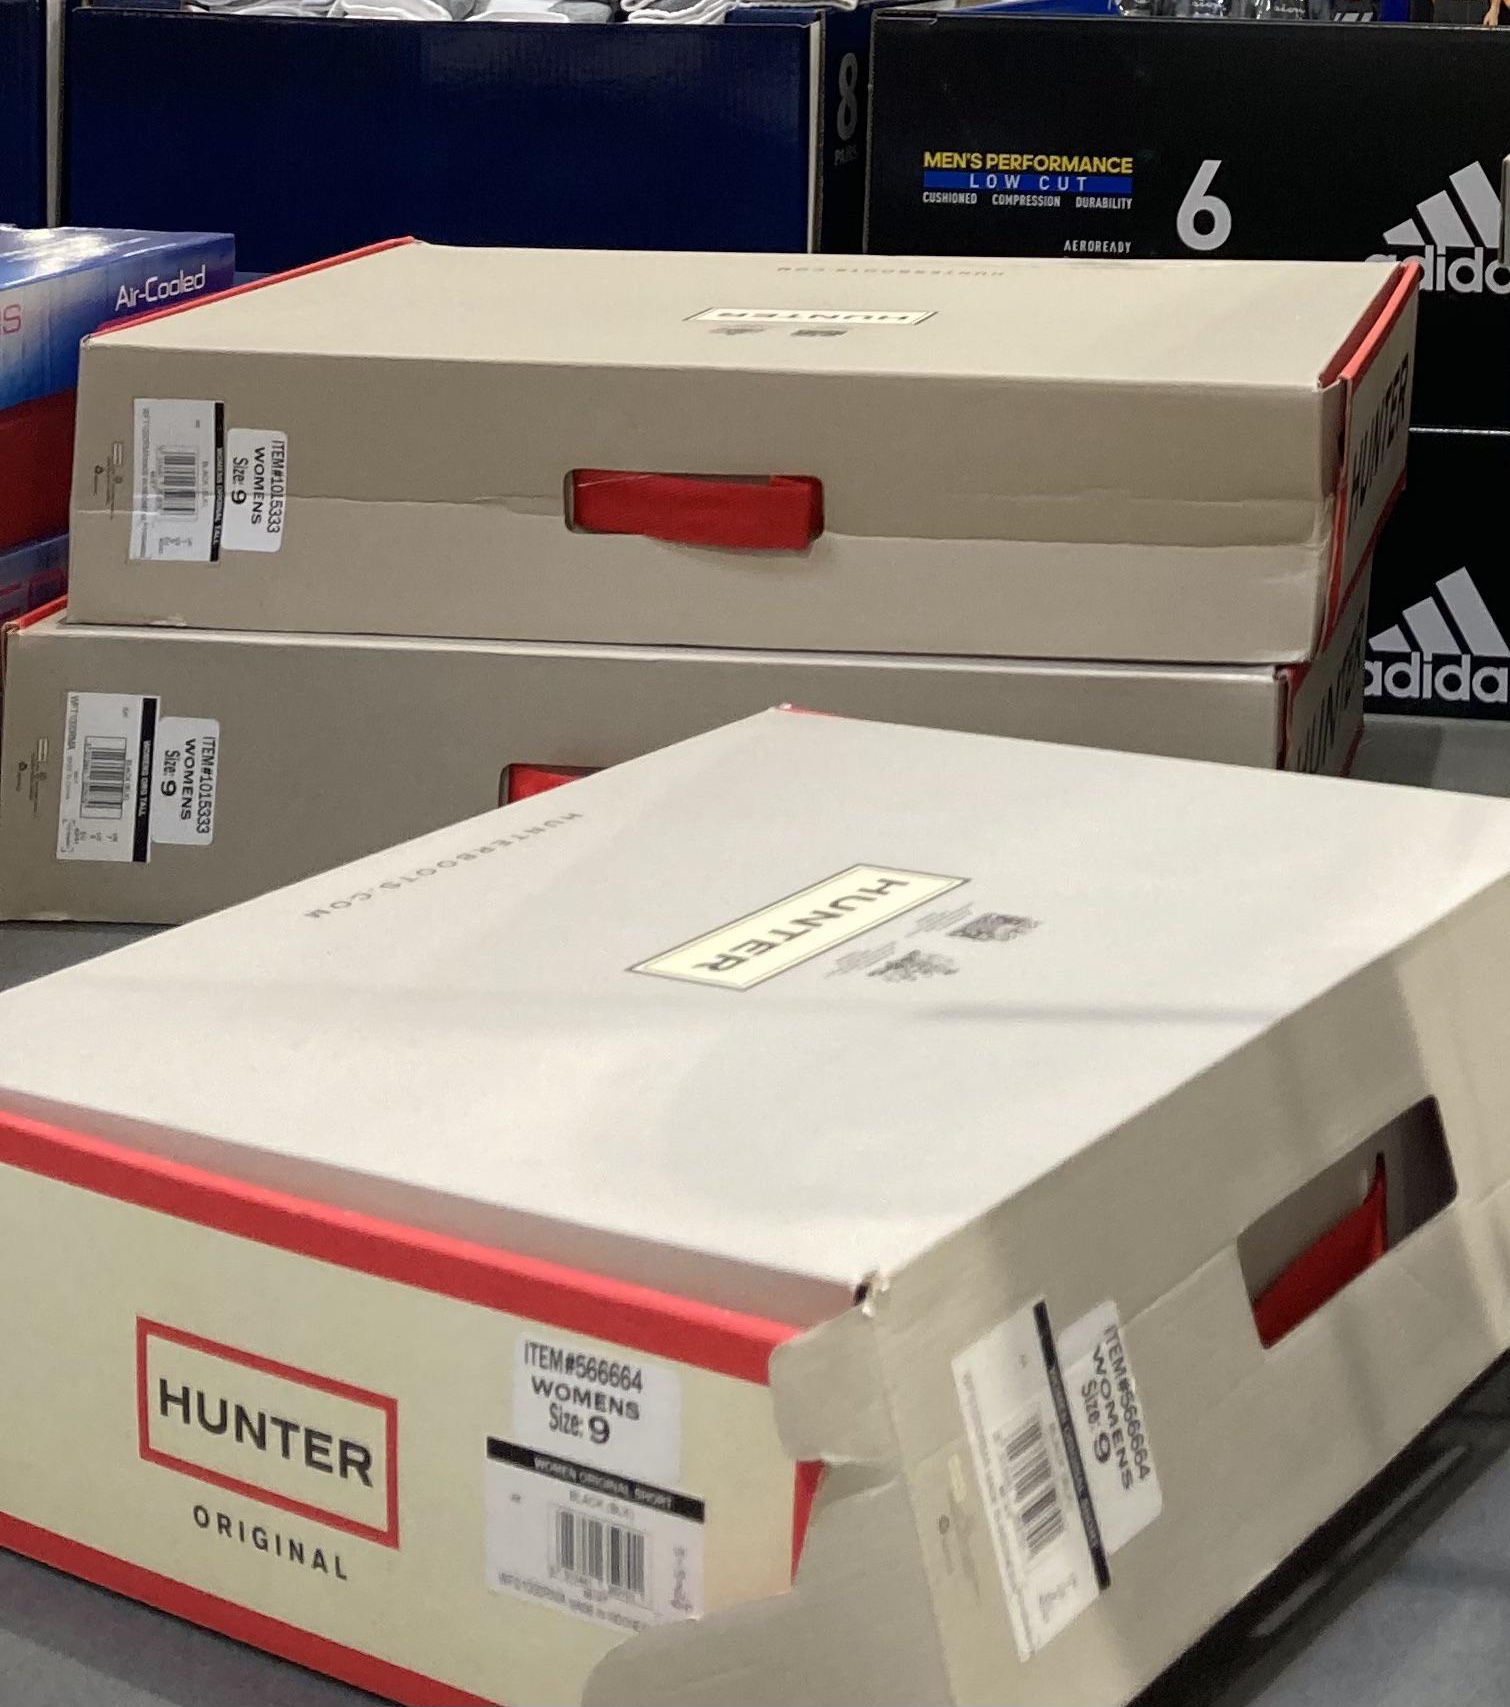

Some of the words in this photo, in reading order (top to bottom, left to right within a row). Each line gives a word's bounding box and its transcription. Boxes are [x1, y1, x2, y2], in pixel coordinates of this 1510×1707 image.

[837, 52, 858, 141] 8
[924, 152, 982, 169] MEN'S
[986, 153, 1133, 173] PERFORMANCE
[970, 174, 1020, 189] LOW
[1039, 176, 1087, 191] CUT
[923, 192, 977, 204] CUSHIONED
[992, 194, 1061, 207] COMPRESSION
[1076, 196, 1132, 209] DURABILITY
[1177, 160, 1232, 251] 6
[1064, 240, 1131, 253] AEROREADY
[115, 265, 206, 311] Air-Cooled
[231, 489, 247, 505] 9
[251, 446, 265, 526] WOMENS
[267, 440, 286, 534] ITEM#1015333
[161, 780, 177, 796] 9
[181, 739, 196, 821] WOMENS
[196, 736, 216, 834] ITEM#1015333
[304, 811, 583, 919] HUNTERBOOTS.COM
[692, 878, 909, 973] HUNTER
[524, 1341, 643, 1393] ITEM#566664
[531, 1375, 640, 1421] WOMENS
[1105, 1325, 1150, 1480] ITEM#566664
[159, 1378, 373, 1488] HUNTER
[588, 1416, 610, 1443] 9
[1093, 1345, 1133, 1490] WOMENS
[1094, 1431, 1111, 1464] 9
[193, 1505, 348, 1580] ORIGINAL
